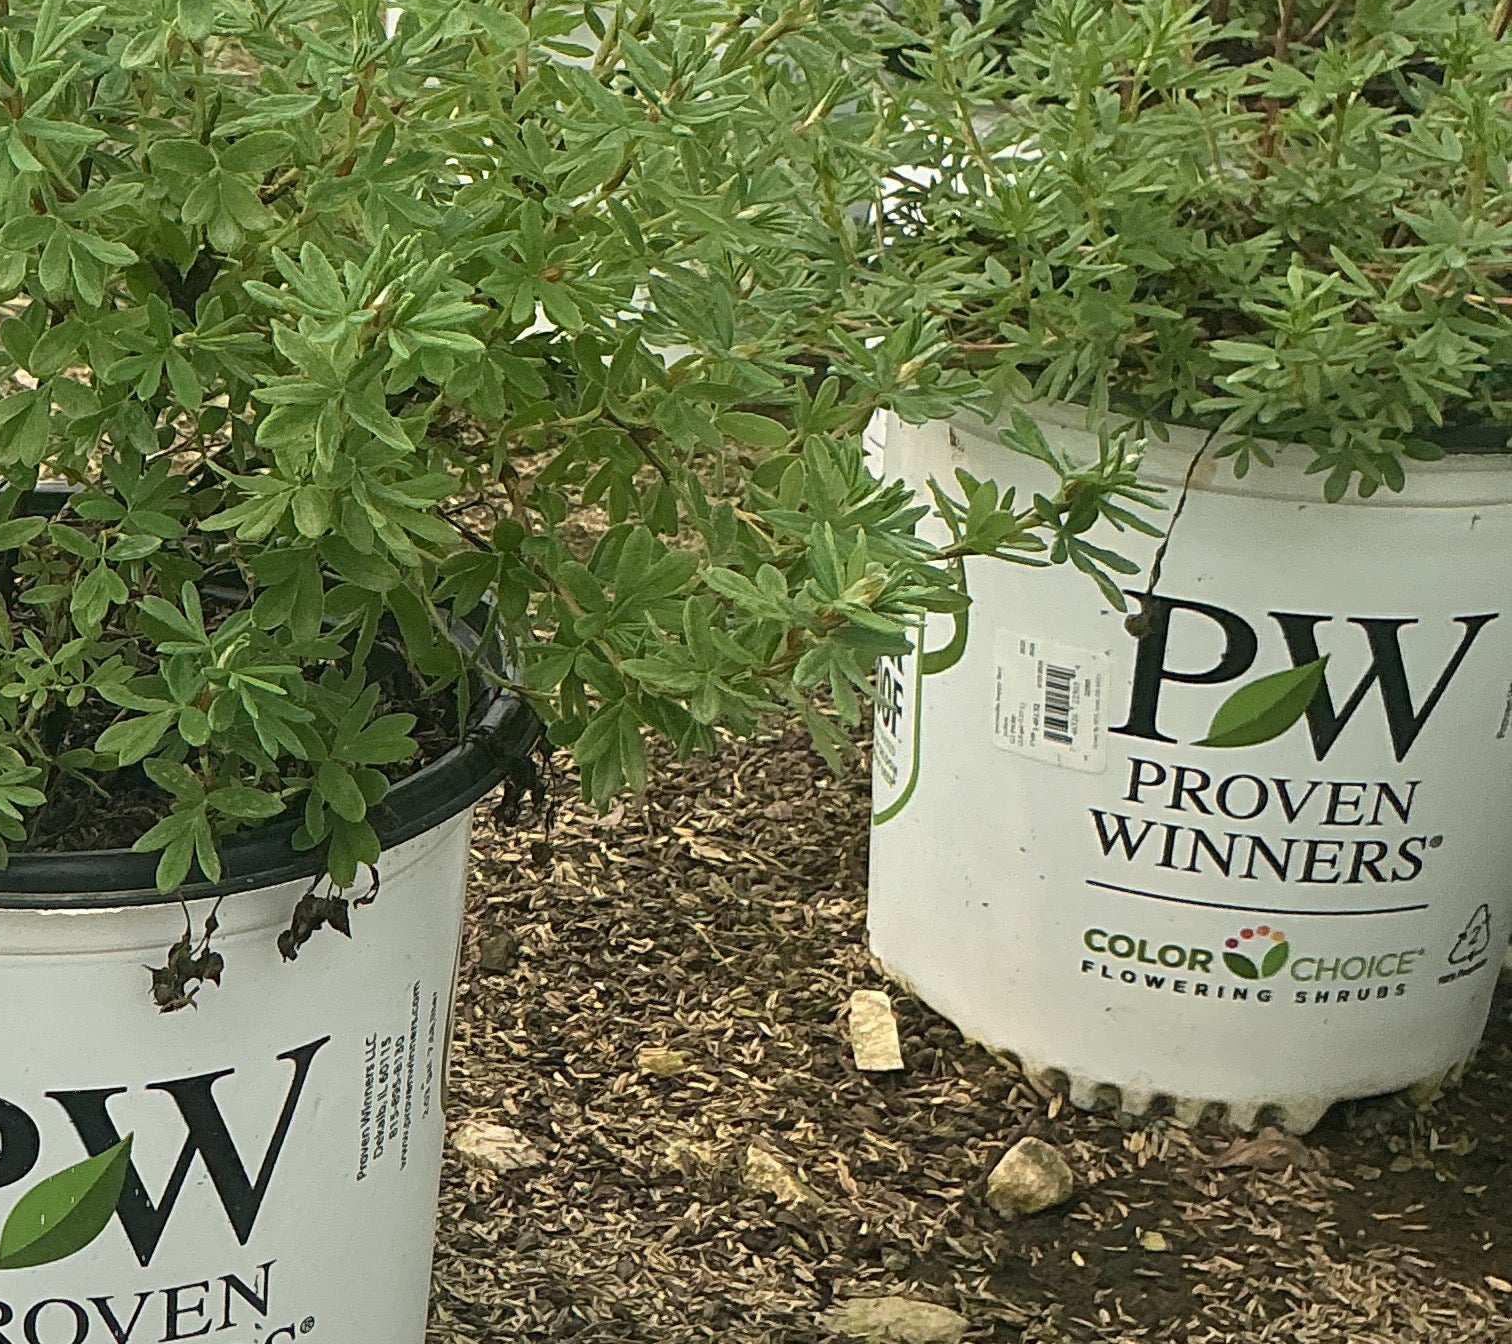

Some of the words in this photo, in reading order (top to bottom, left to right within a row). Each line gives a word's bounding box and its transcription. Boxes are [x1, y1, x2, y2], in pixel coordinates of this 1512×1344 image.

[1122, 757, 1422, 826] PROVEN
[1083, 928, 1214, 974] COLOR
[1081, 960, 1272, 1003] FLOWERING
[1295, 983, 1407, 1004] SHRUBS
[357, 1127, 371, 1181] Proven
[366, 1032, 377, 1062] LLC
